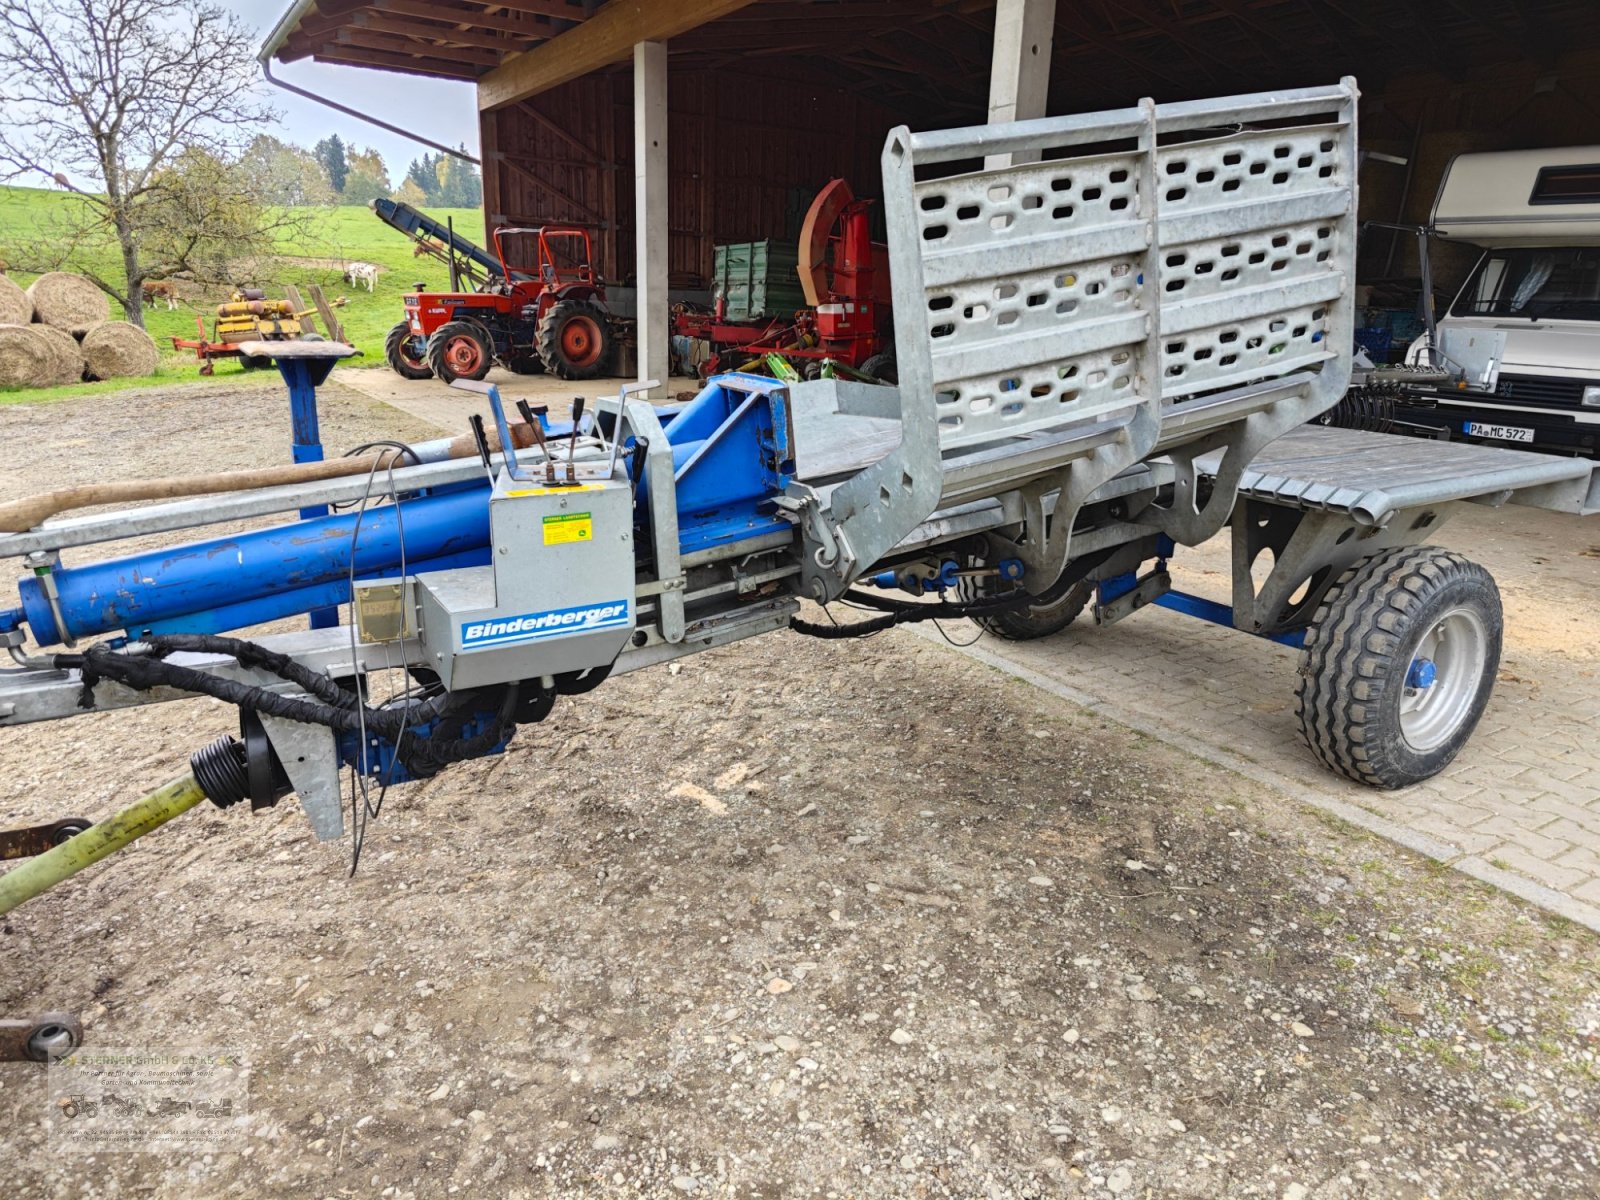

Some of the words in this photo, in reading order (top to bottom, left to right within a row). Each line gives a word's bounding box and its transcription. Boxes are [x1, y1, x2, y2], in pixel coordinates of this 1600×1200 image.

[1471, 423, 1483, 435] PA
[1490, 426, 1504, 438] MC
[1506, 428, 1526, 440] 572
[465, 604, 625, 640] Binderberger
